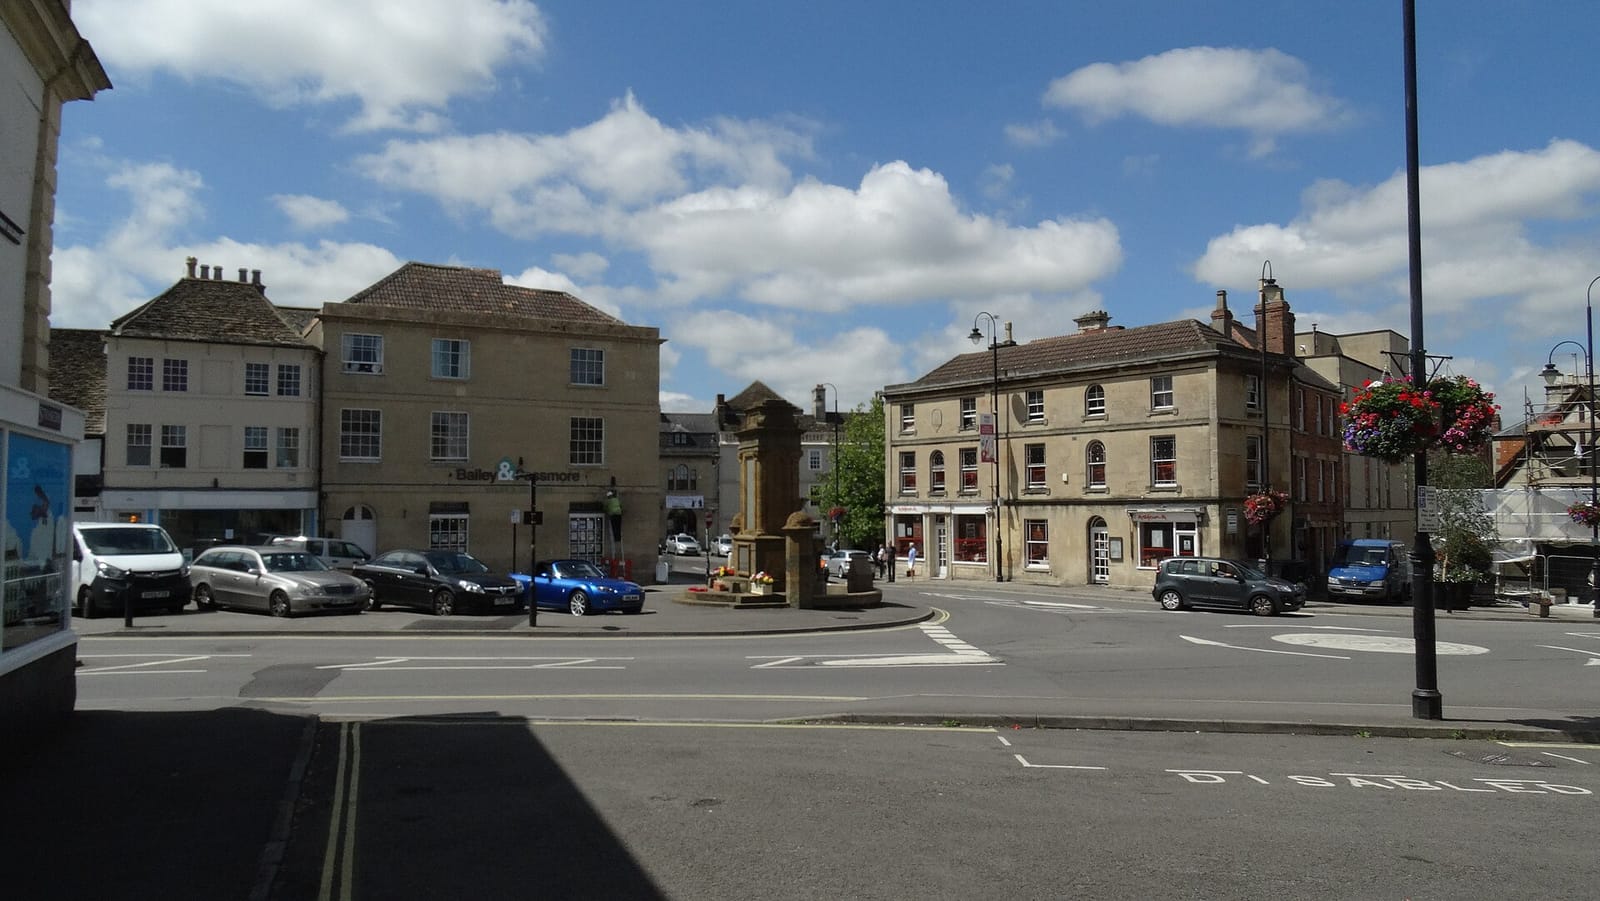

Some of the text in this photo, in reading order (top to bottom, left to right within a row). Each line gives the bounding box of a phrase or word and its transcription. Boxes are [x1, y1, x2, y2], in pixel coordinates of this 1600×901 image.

[456, 468, 498, 483] Bailey
[497, 461, 516, 481] &
[1178, 773, 1593, 795] DISABLED
